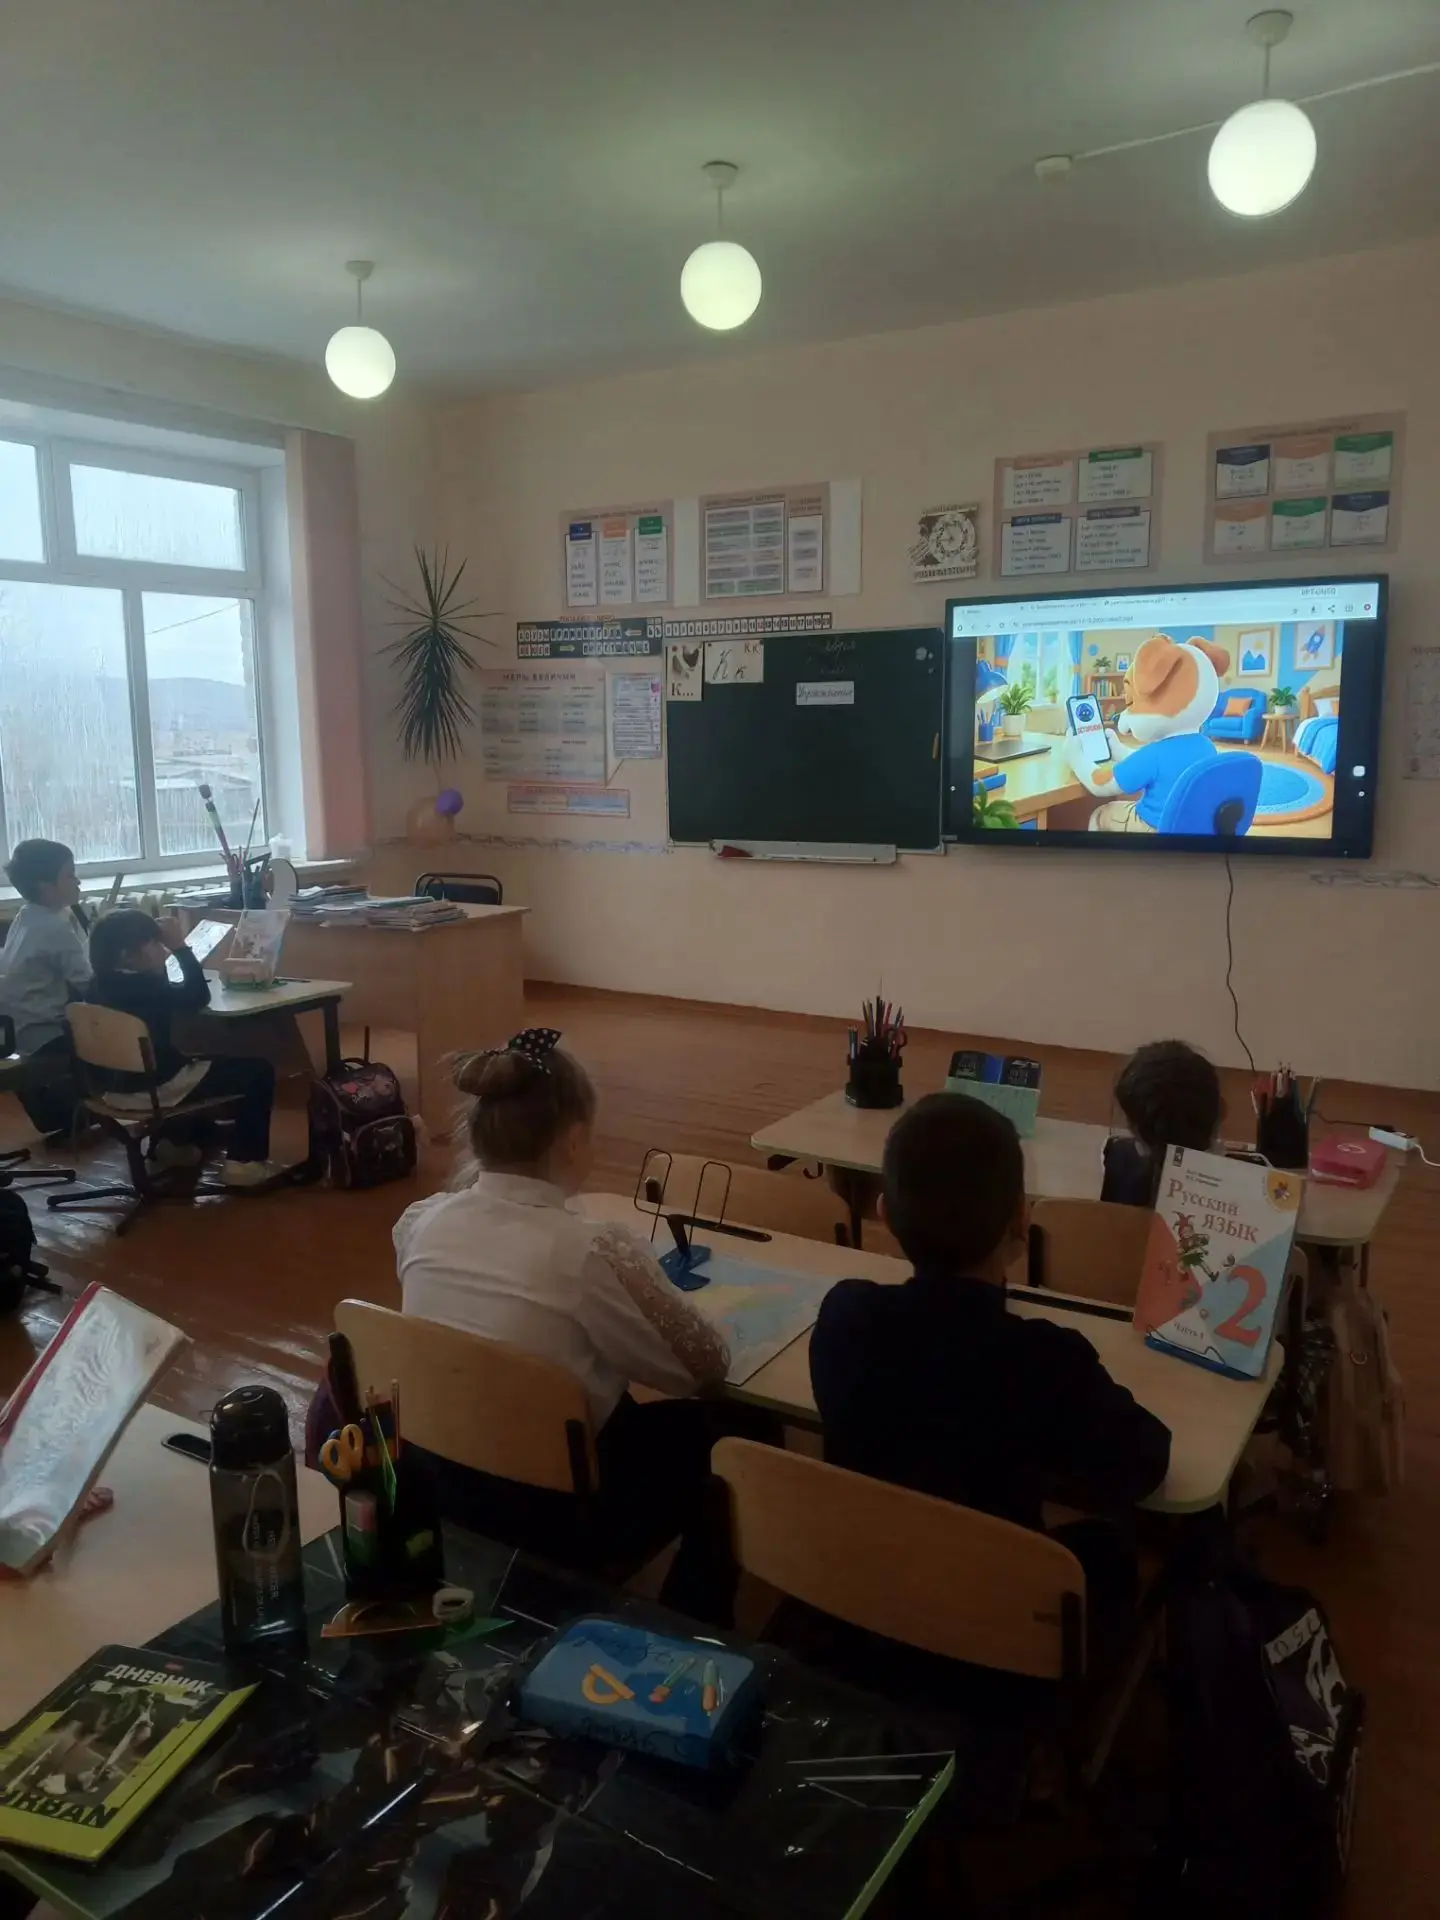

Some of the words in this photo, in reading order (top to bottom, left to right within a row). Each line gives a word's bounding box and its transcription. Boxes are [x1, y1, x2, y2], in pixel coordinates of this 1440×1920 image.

[1166, 1178, 1240, 1216] Русский
[1214, 1264, 1268, 1348] 2
[104, 1663, 215, 1695] ДНЕВНИК
